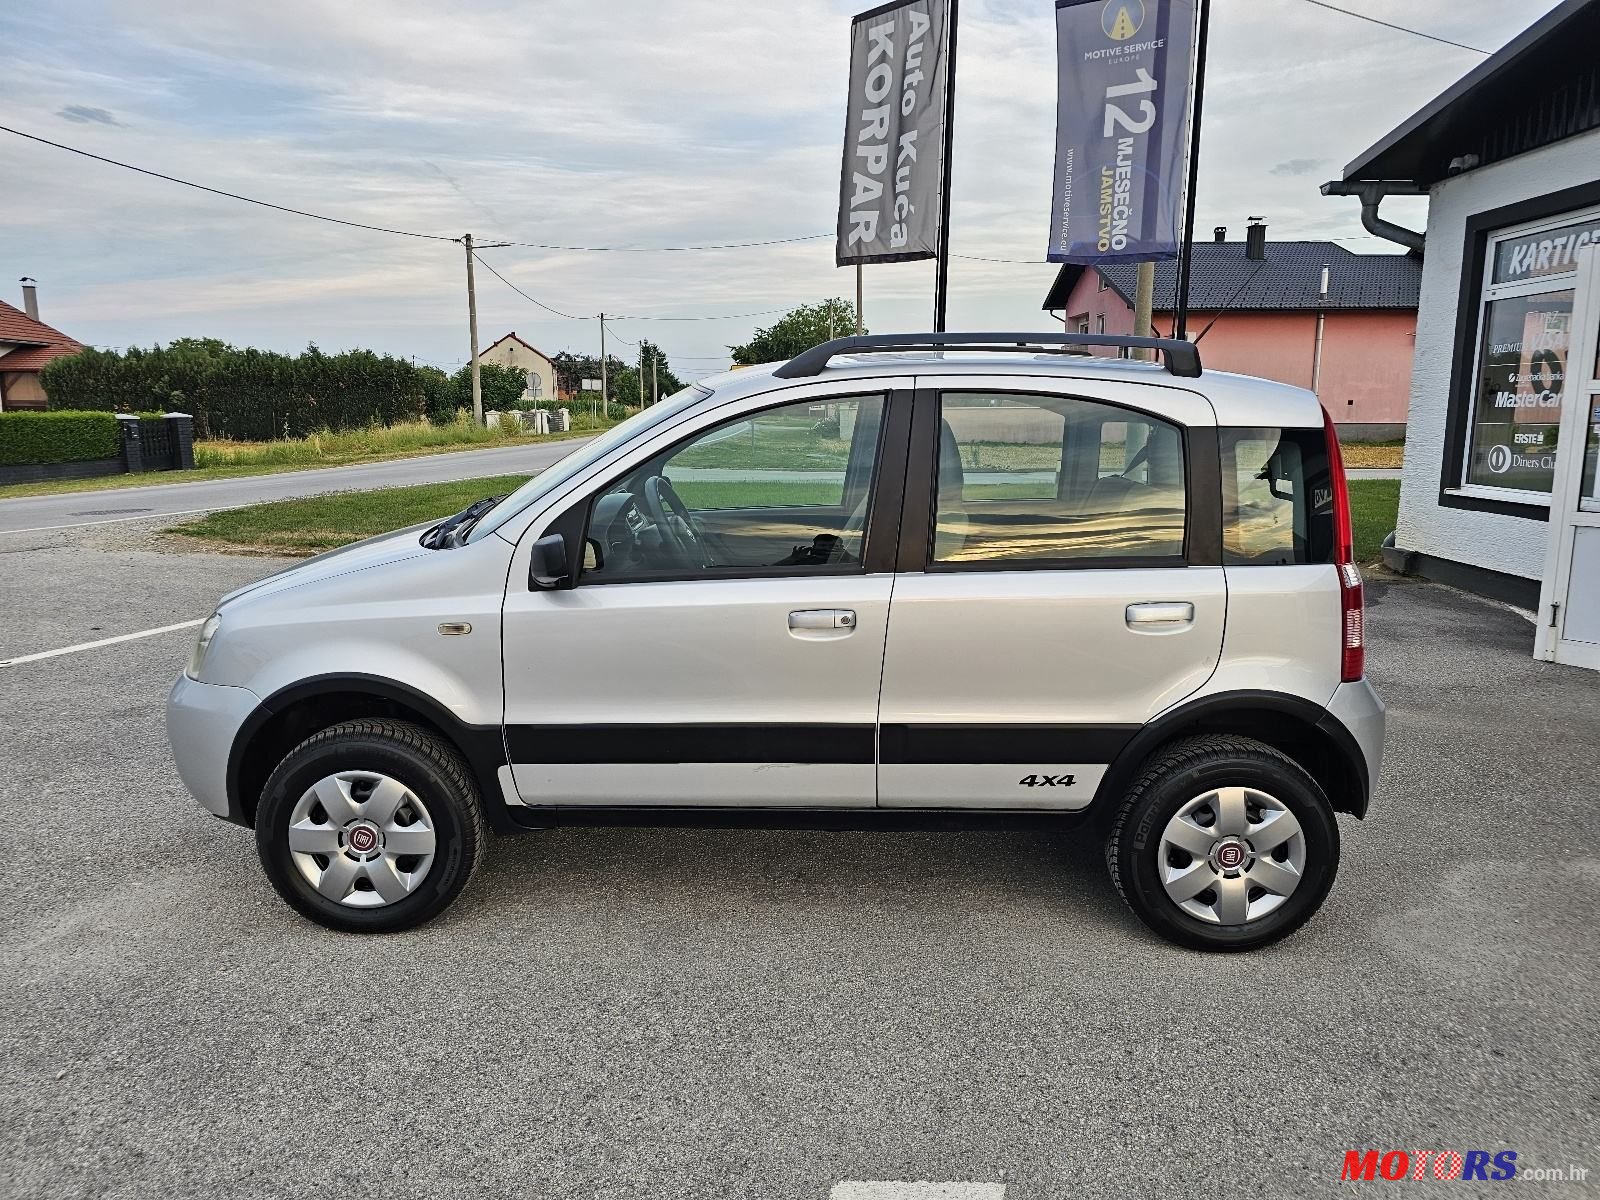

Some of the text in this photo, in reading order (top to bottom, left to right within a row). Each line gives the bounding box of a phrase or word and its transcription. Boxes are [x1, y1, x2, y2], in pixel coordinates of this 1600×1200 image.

[1084, 39, 1164, 60] MOTIVE SERVICE
[1108, 54, 1140, 65] EUROPE
[848, 20, 895, 247] KORPAR
[890, 9, 930, 249] Auto Kuća
[1104, 68, 1158, 251] 12 MJESEČNO
[1060, 148, 1074, 251] www.motiveservice.eu
[1097, 165, 1115, 252] JAMSTVO
[1513, 433, 1538, 444] ERSTE
[1512, 454, 1540, 468] Diners
[356, 833, 370, 845] FIAT
[1225, 849, 1236, 862] FIAT
